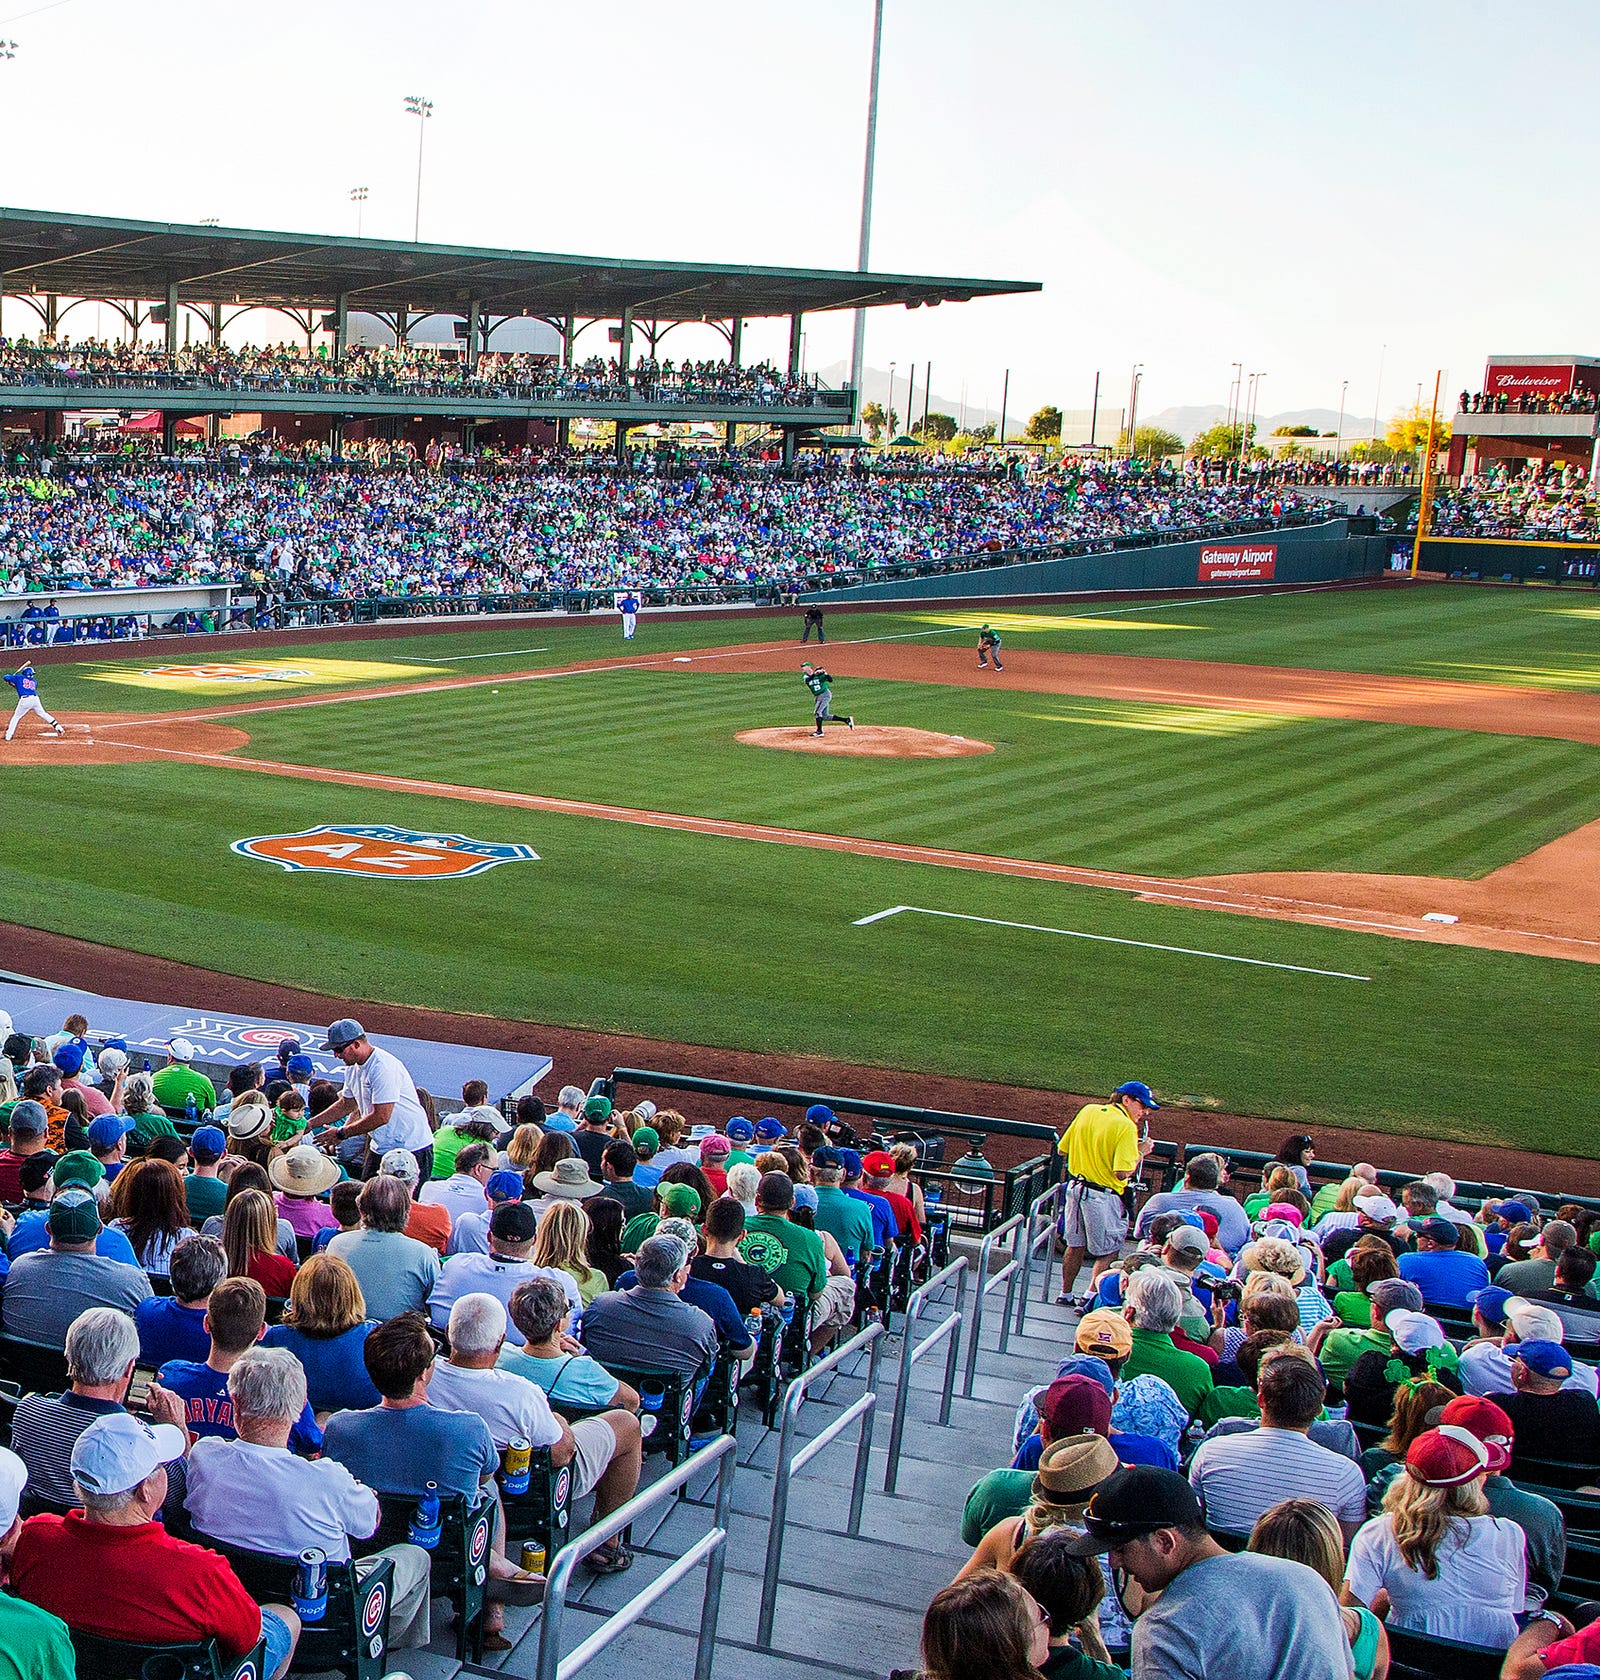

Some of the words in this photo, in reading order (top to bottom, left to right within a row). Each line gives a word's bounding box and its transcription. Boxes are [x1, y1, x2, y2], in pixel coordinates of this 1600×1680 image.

[1495, 374, 1561, 387] Budweiser
[1201, 550, 1240, 567] Gateway
[1241, 548, 1274, 566] Airport
[1210, 569, 1261, 579] gatewayairport.com
[281, 842, 447, 869] AZ
